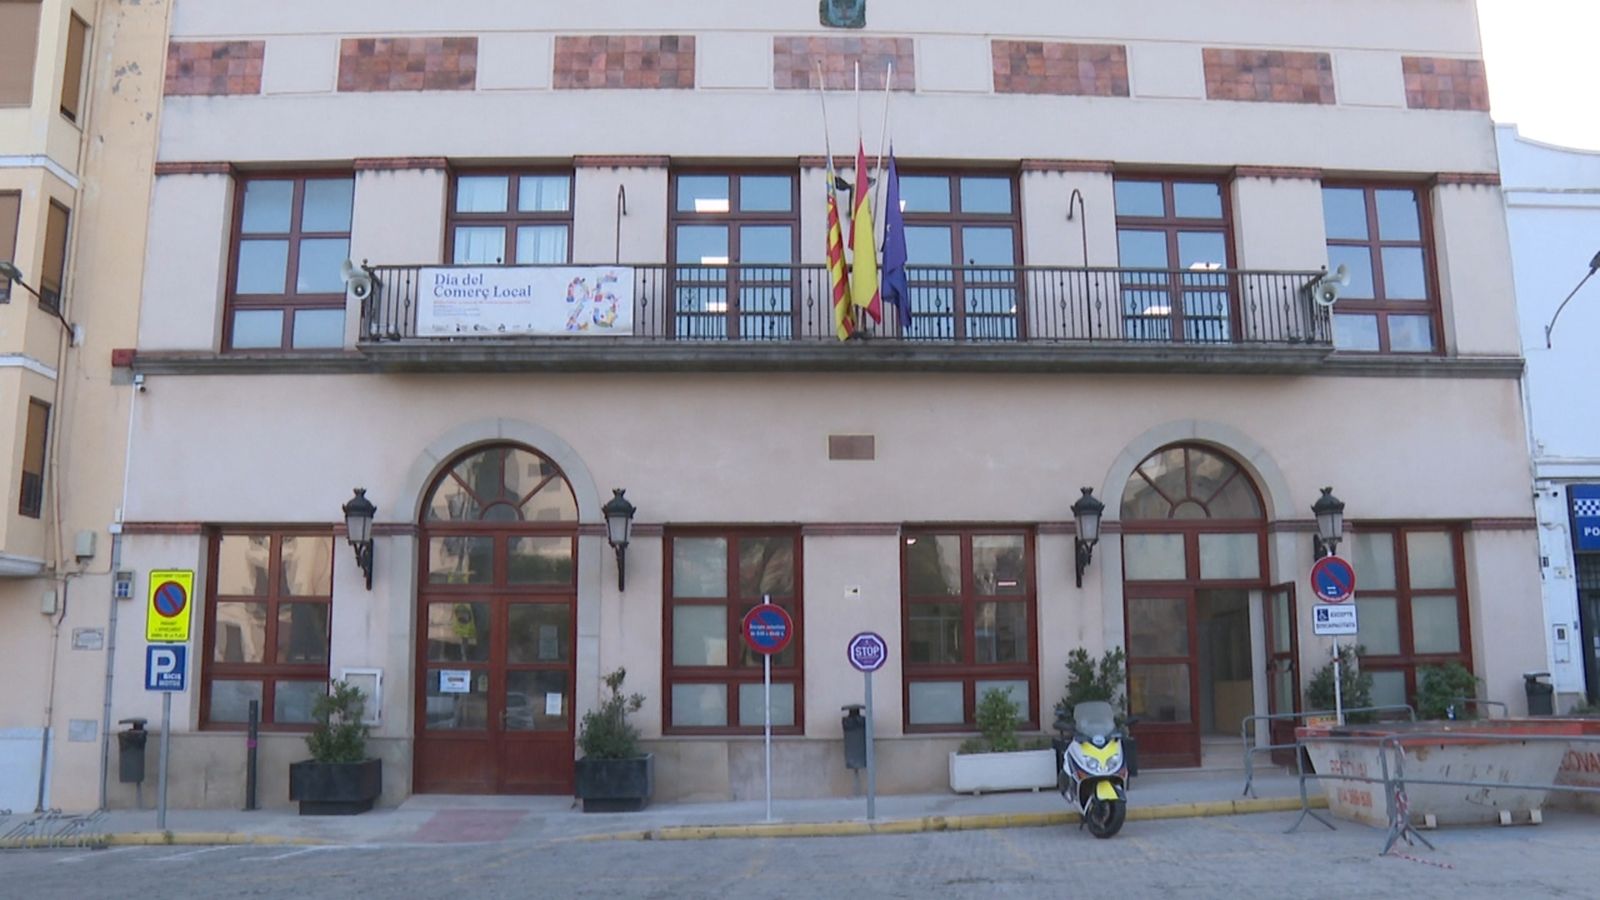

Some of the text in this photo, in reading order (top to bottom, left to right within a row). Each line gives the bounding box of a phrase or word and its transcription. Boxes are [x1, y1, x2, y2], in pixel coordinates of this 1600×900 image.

[462, 273, 483, 285] del
[434, 285, 531, 300] Comerç Local
[1584, 527, 1600, 537] PO
[855, 646, 879, 656] STOP
[150, 649, 176, 686] P
